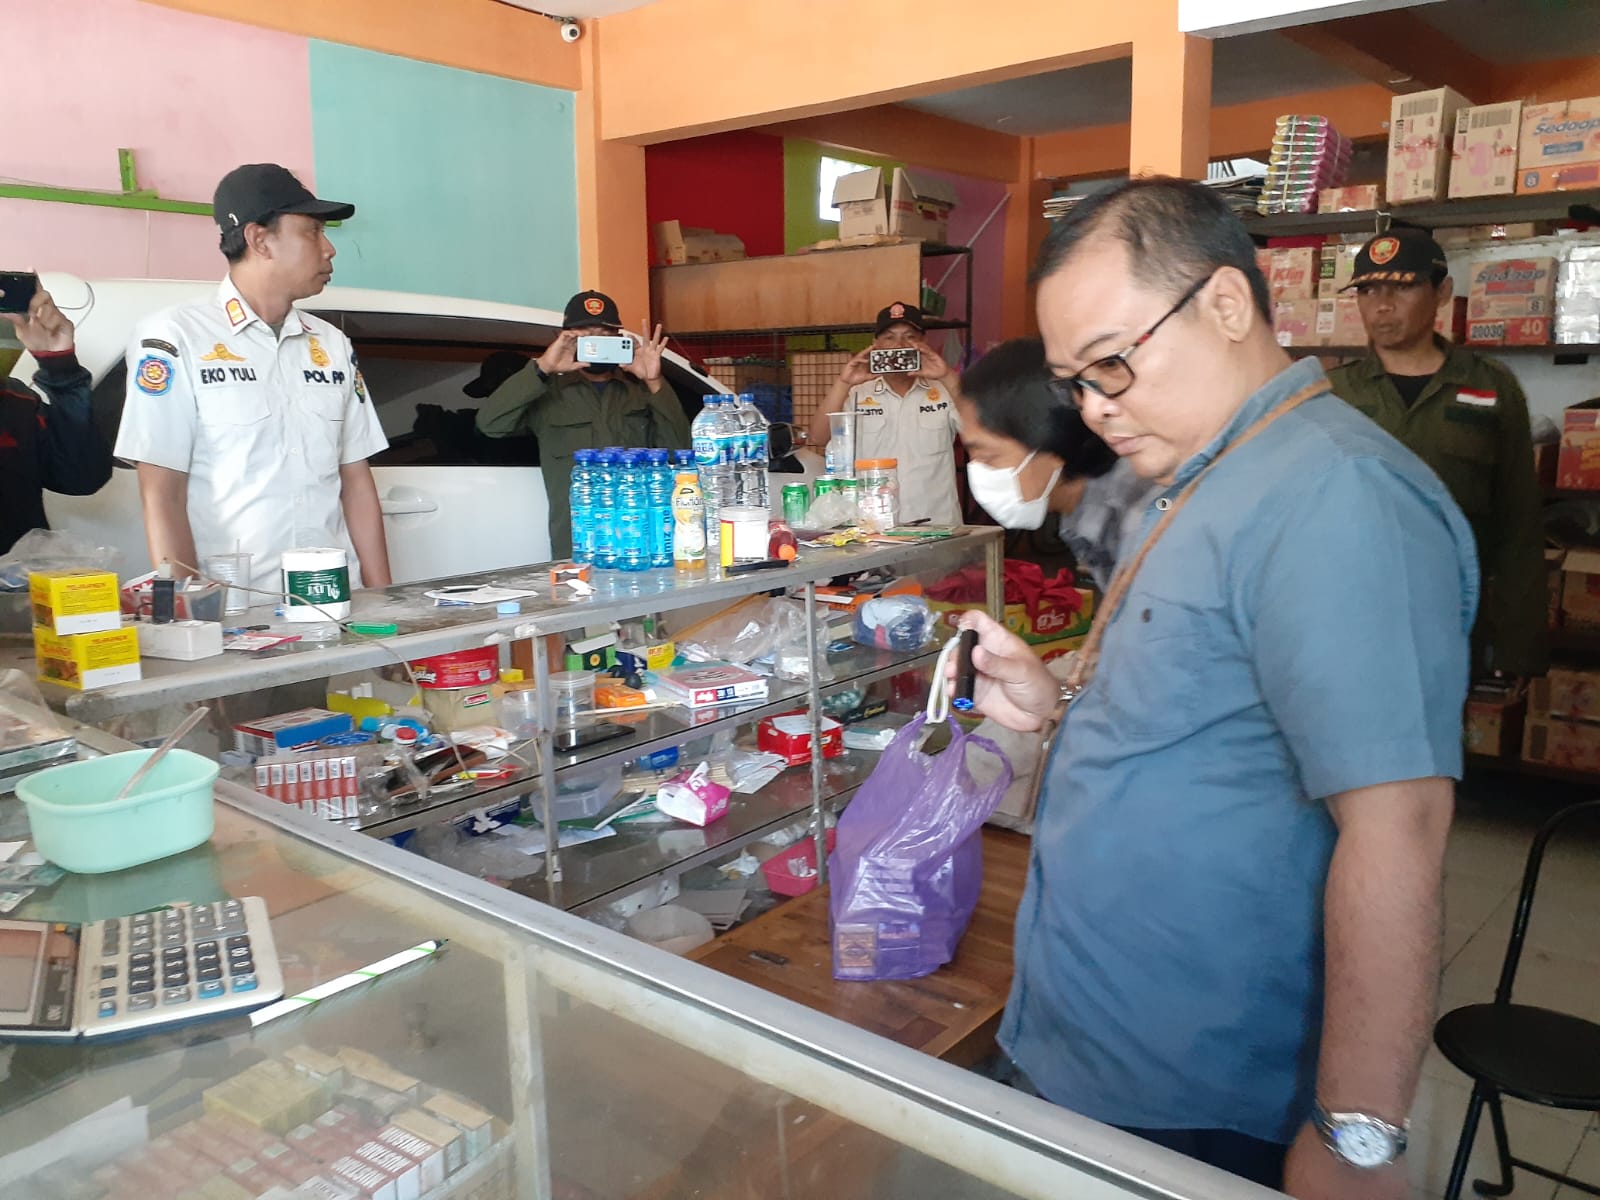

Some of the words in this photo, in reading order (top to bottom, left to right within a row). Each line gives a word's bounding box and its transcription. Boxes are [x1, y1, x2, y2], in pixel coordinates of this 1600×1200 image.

[1521, 319, 1543, 336] 40
[200, 368, 226, 384] EKO
[229, 367, 257, 382] YULI
[303, 370, 330, 384] POL
[332, 370, 345, 384] PP
[919, 405, 936, 413] POL
[937, 402, 948, 410] PP
